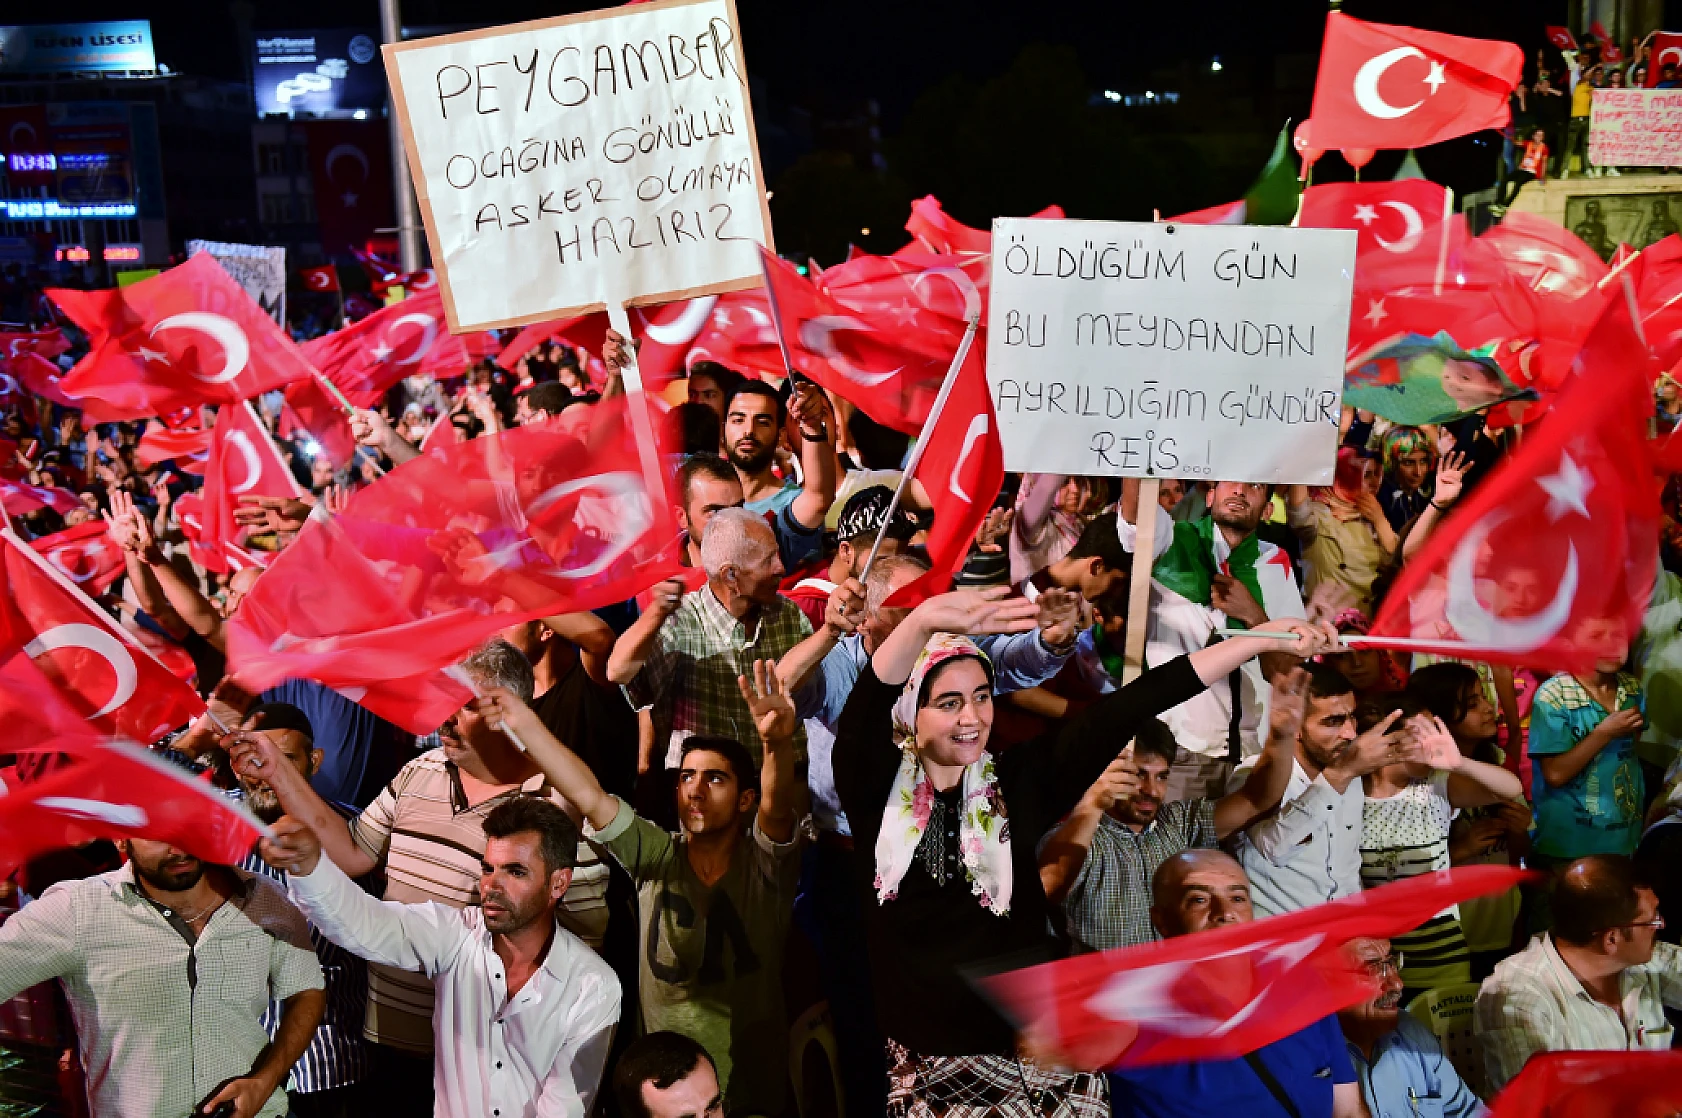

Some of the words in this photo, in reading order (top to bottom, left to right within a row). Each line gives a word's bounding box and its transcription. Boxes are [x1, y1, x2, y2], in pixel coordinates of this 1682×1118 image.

[436, 17, 746, 119] PEYGAMBER
[446, 136, 586, 189] OCAĞINA
[602, 96, 735, 164] GÖNÜLLÜ
[475, 179, 621, 233] ASKER
[637, 157, 752, 202] OLMAYA
[1005, 235, 1186, 282] ÖLDÜĞÜM
[1213, 241, 1298, 288] GÜN
[1004, 309, 1047, 348] BU
[1076, 312, 1315, 358] MEYDANDAN
[997, 379, 1207, 421] AYRILDIĞIM
[1218, 383, 1340, 428] GÜNDÜR
